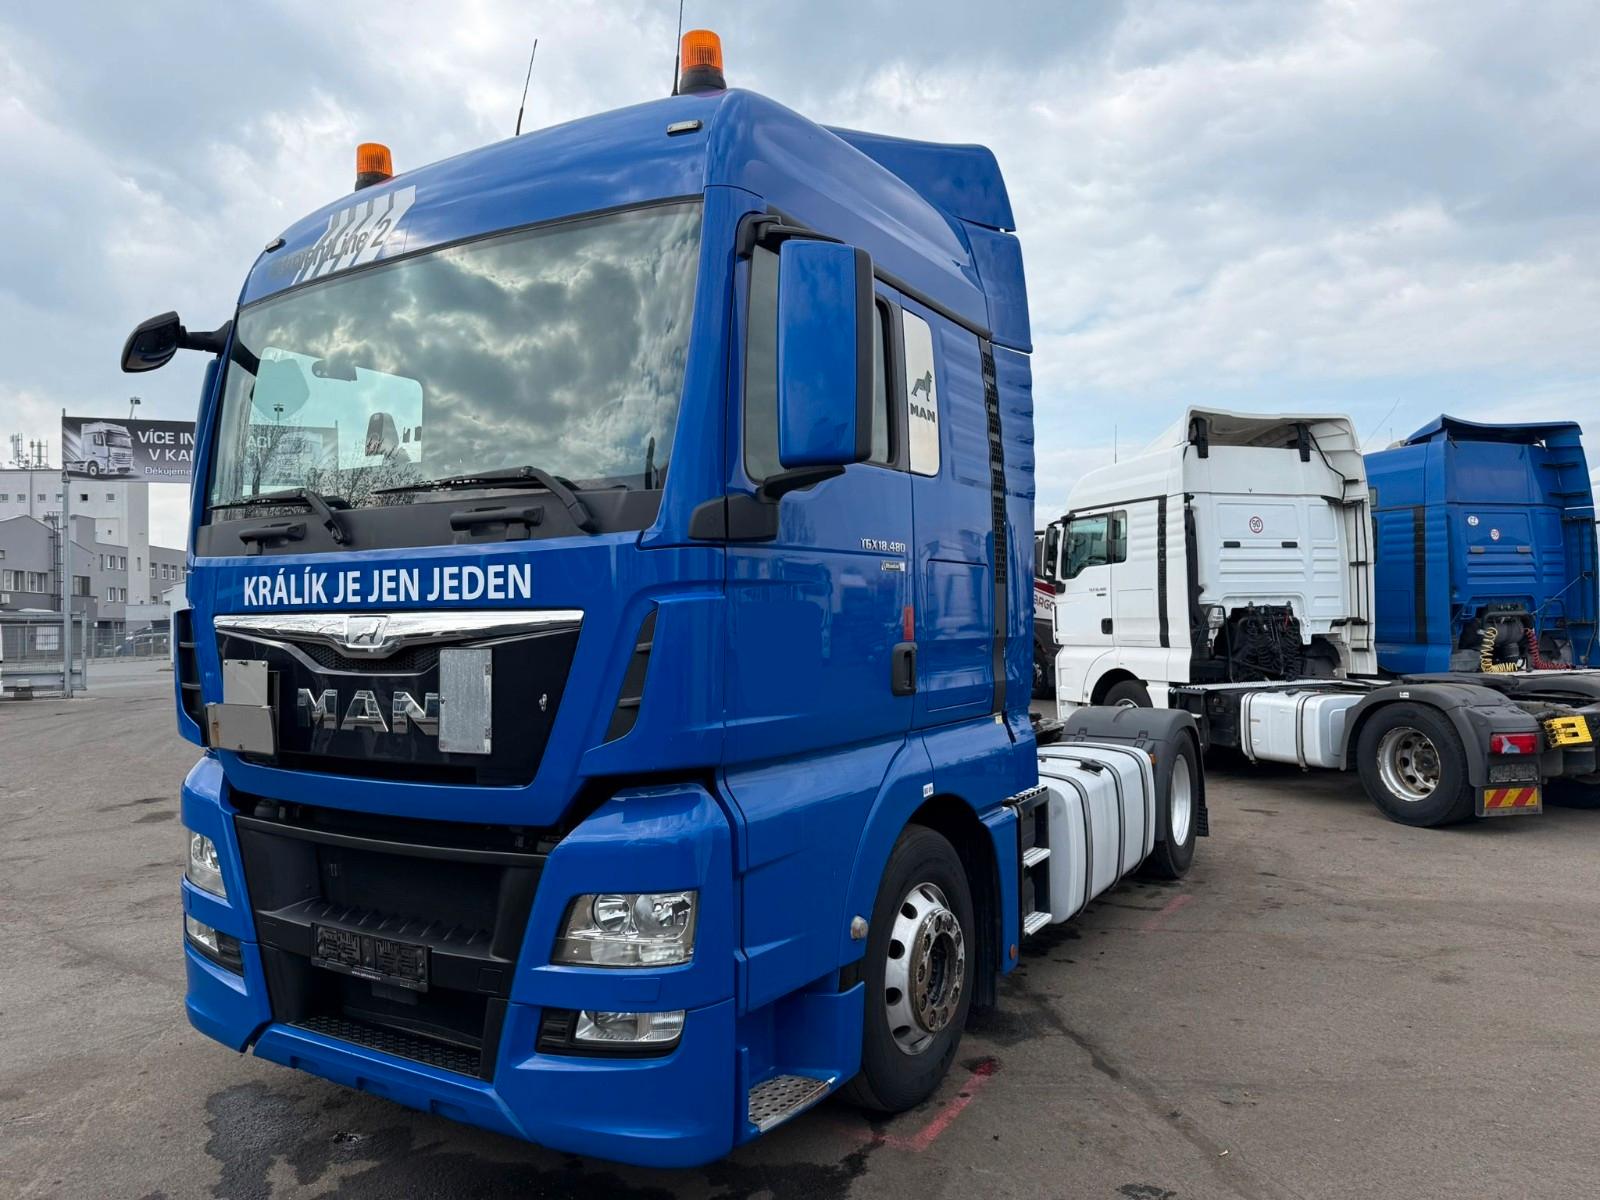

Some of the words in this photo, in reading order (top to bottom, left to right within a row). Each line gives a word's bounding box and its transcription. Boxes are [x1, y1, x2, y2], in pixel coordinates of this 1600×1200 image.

[371, 218, 391, 248] 2
[910, 403, 936, 423] MAN
[137, 428, 176, 445] VÍCE
[148, 448, 160, 461] V
[244, 566, 329, 606] KRÁLÍK
[333, 571, 361, 604] JE
[367, 568, 419, 603] JEN
[426, 563, 532, 602] JEDEN
[297, 687, 439, 736] MAN
